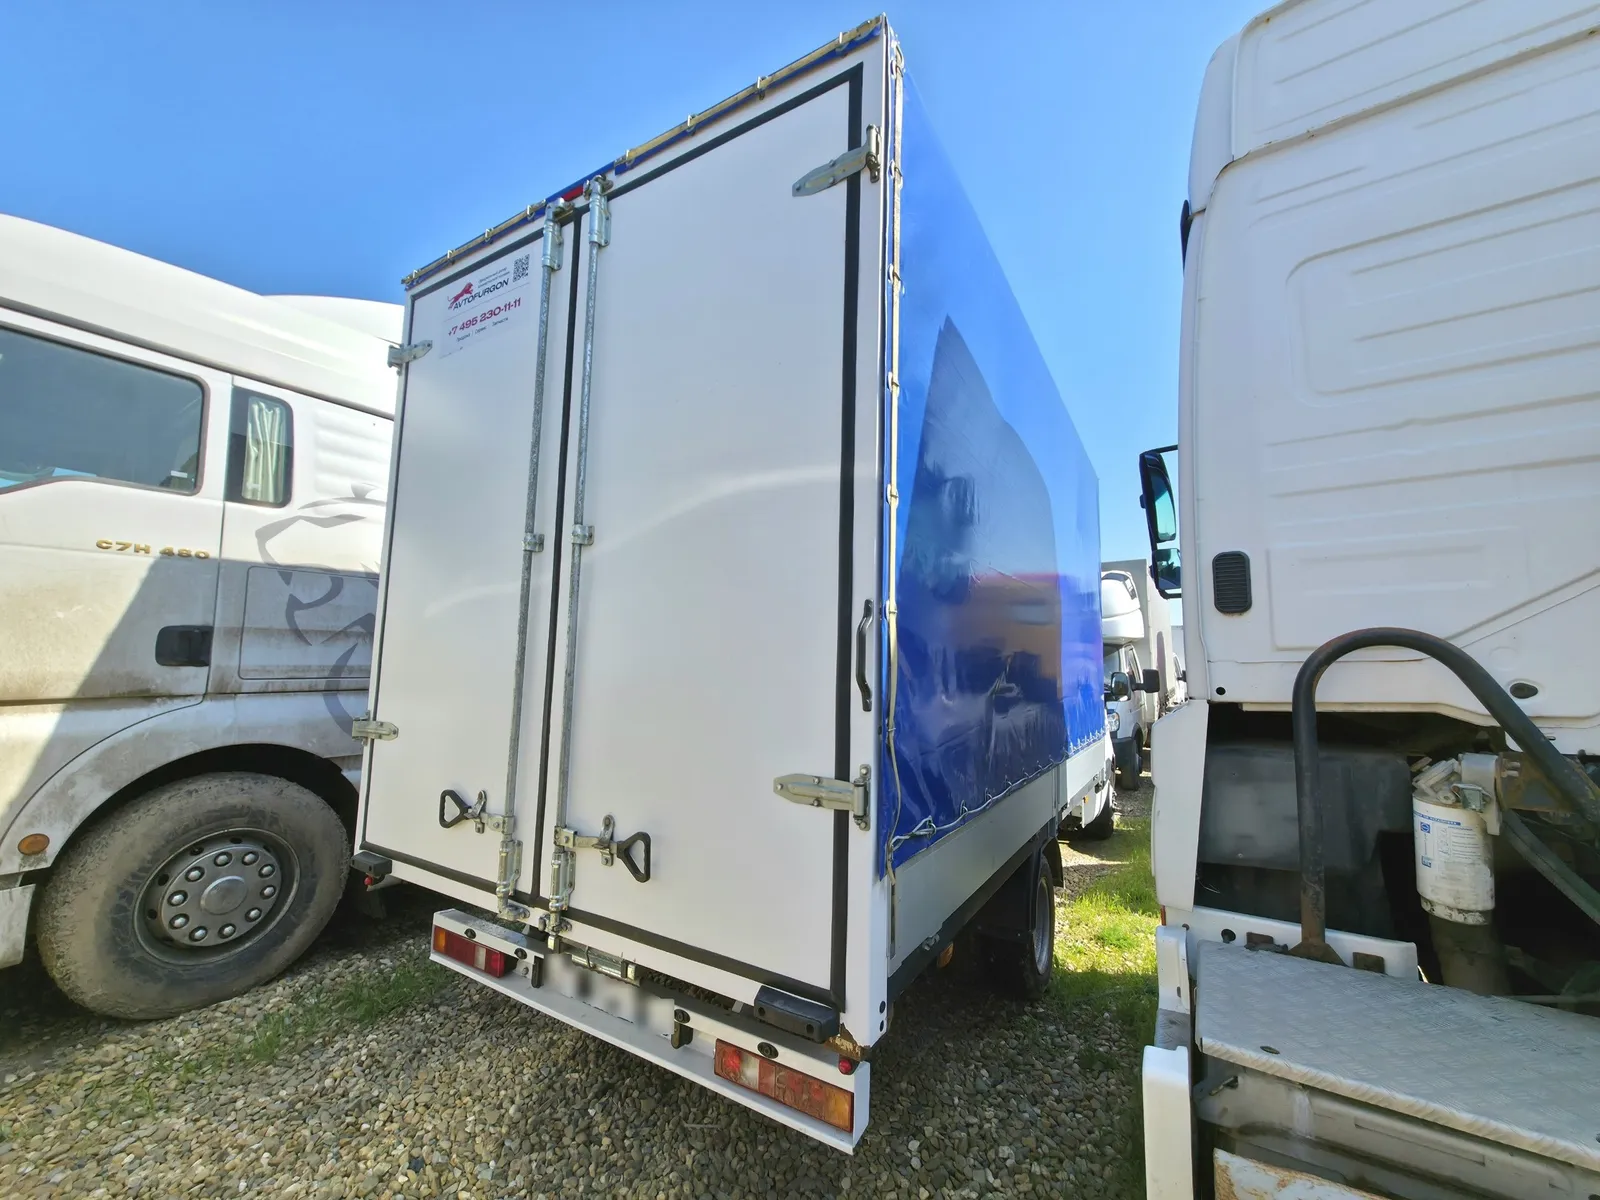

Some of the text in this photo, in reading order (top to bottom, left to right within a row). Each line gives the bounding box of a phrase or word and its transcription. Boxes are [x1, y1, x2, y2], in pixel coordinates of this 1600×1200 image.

[453, 278, 510, 311] AVTOFURGON
[448, 297, 522, 336] +7 495 230-11-11
[96, 539, 151, 554] C7H
